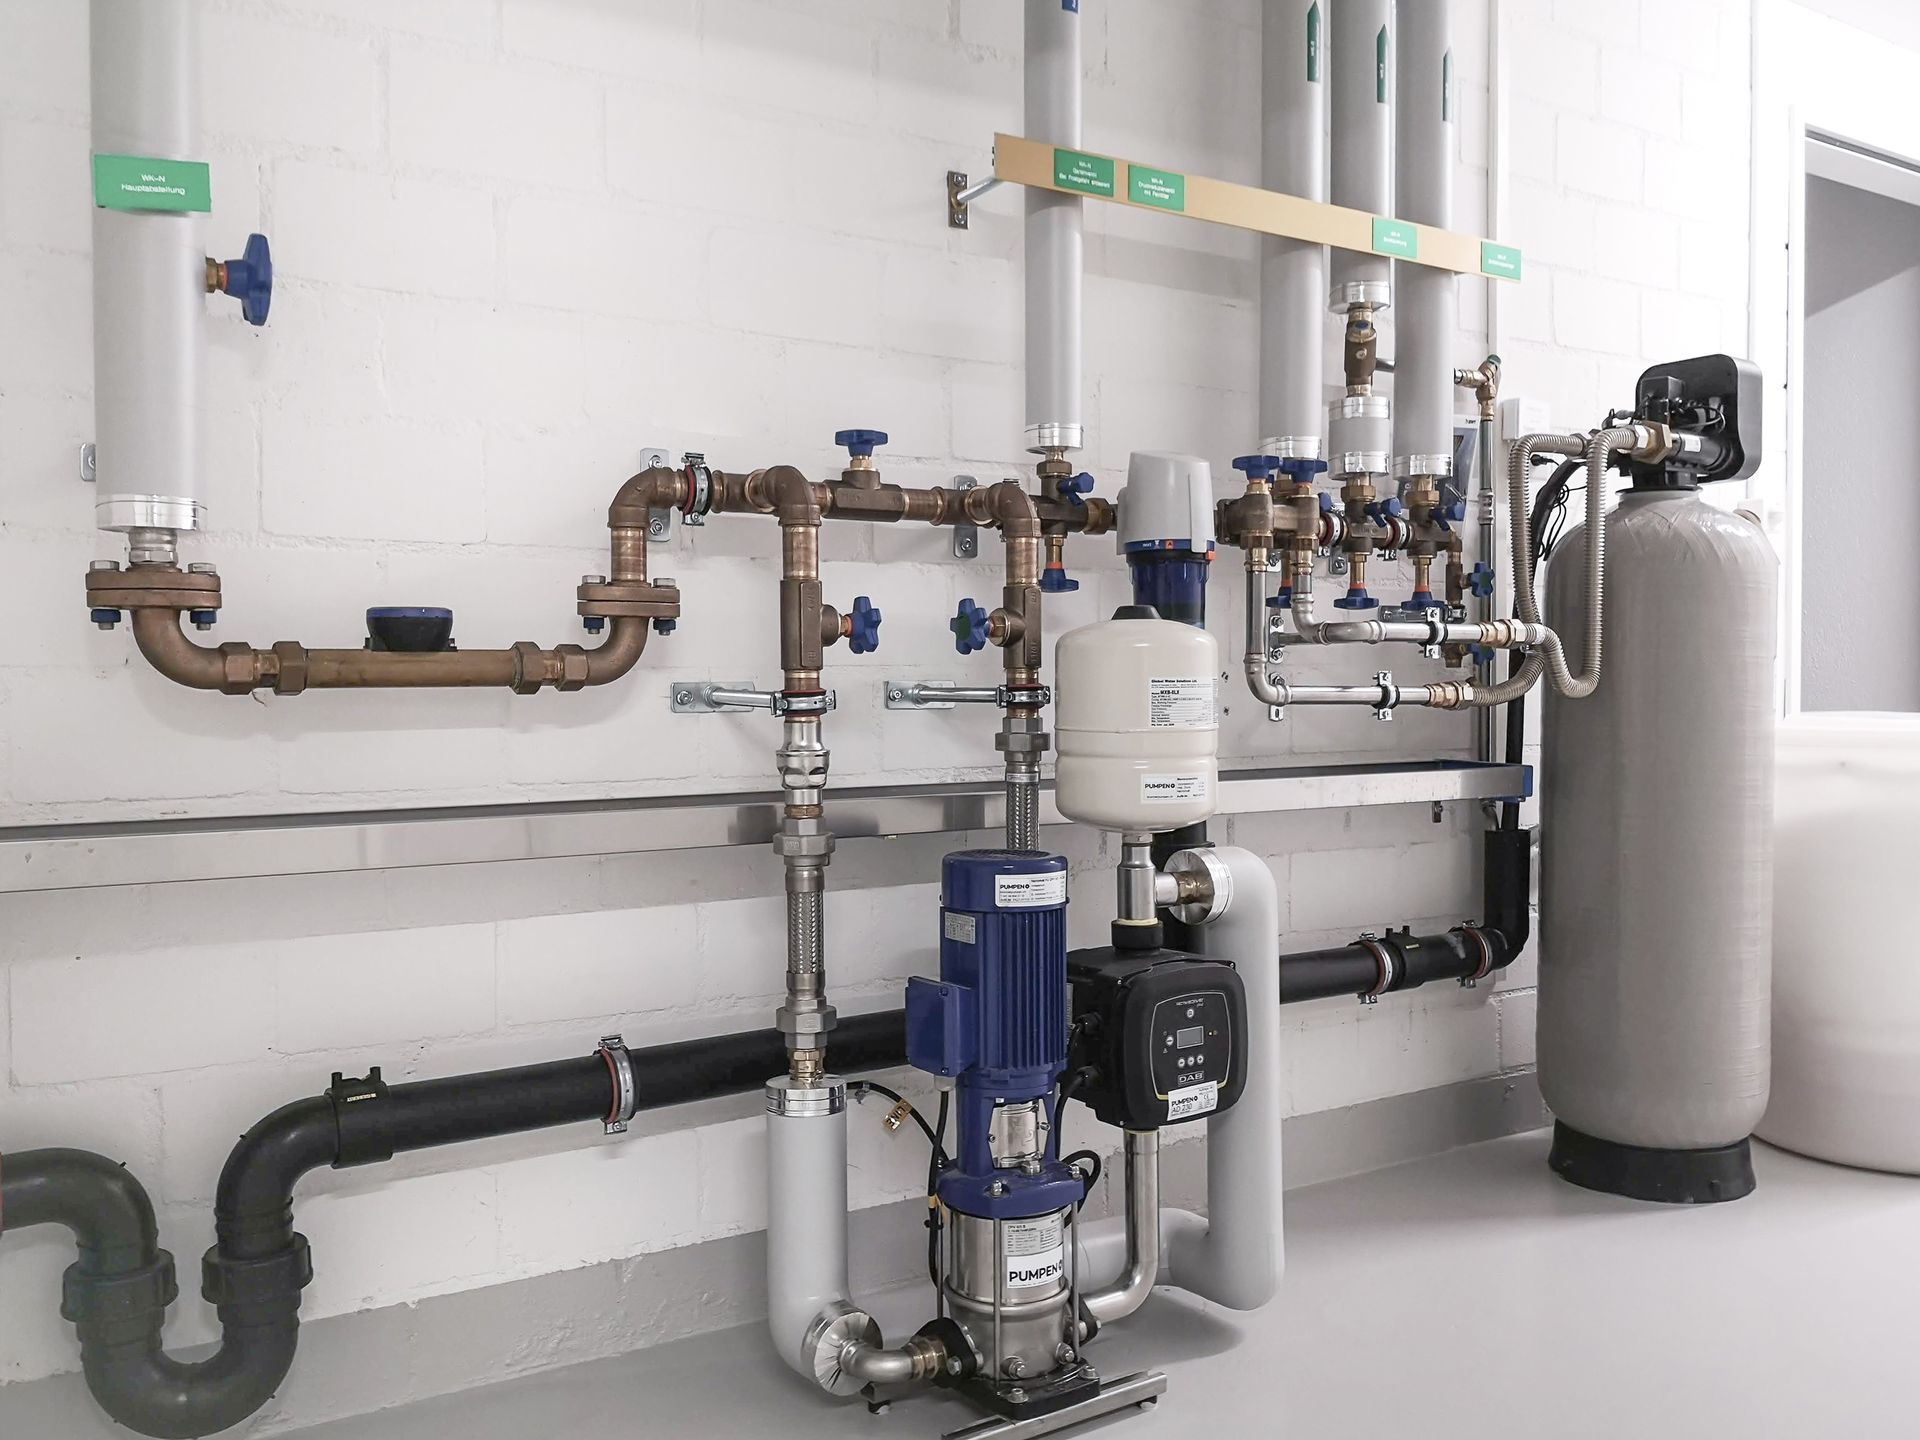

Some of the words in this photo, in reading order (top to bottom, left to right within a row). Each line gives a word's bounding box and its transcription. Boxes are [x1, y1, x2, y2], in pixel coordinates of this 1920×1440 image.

[1180, 1073, 1203, 1082] DAB
[1171, 1096, 1194, 1107] PUMPEN
[1009, 1262, 1059, 1283] PUMPEN
